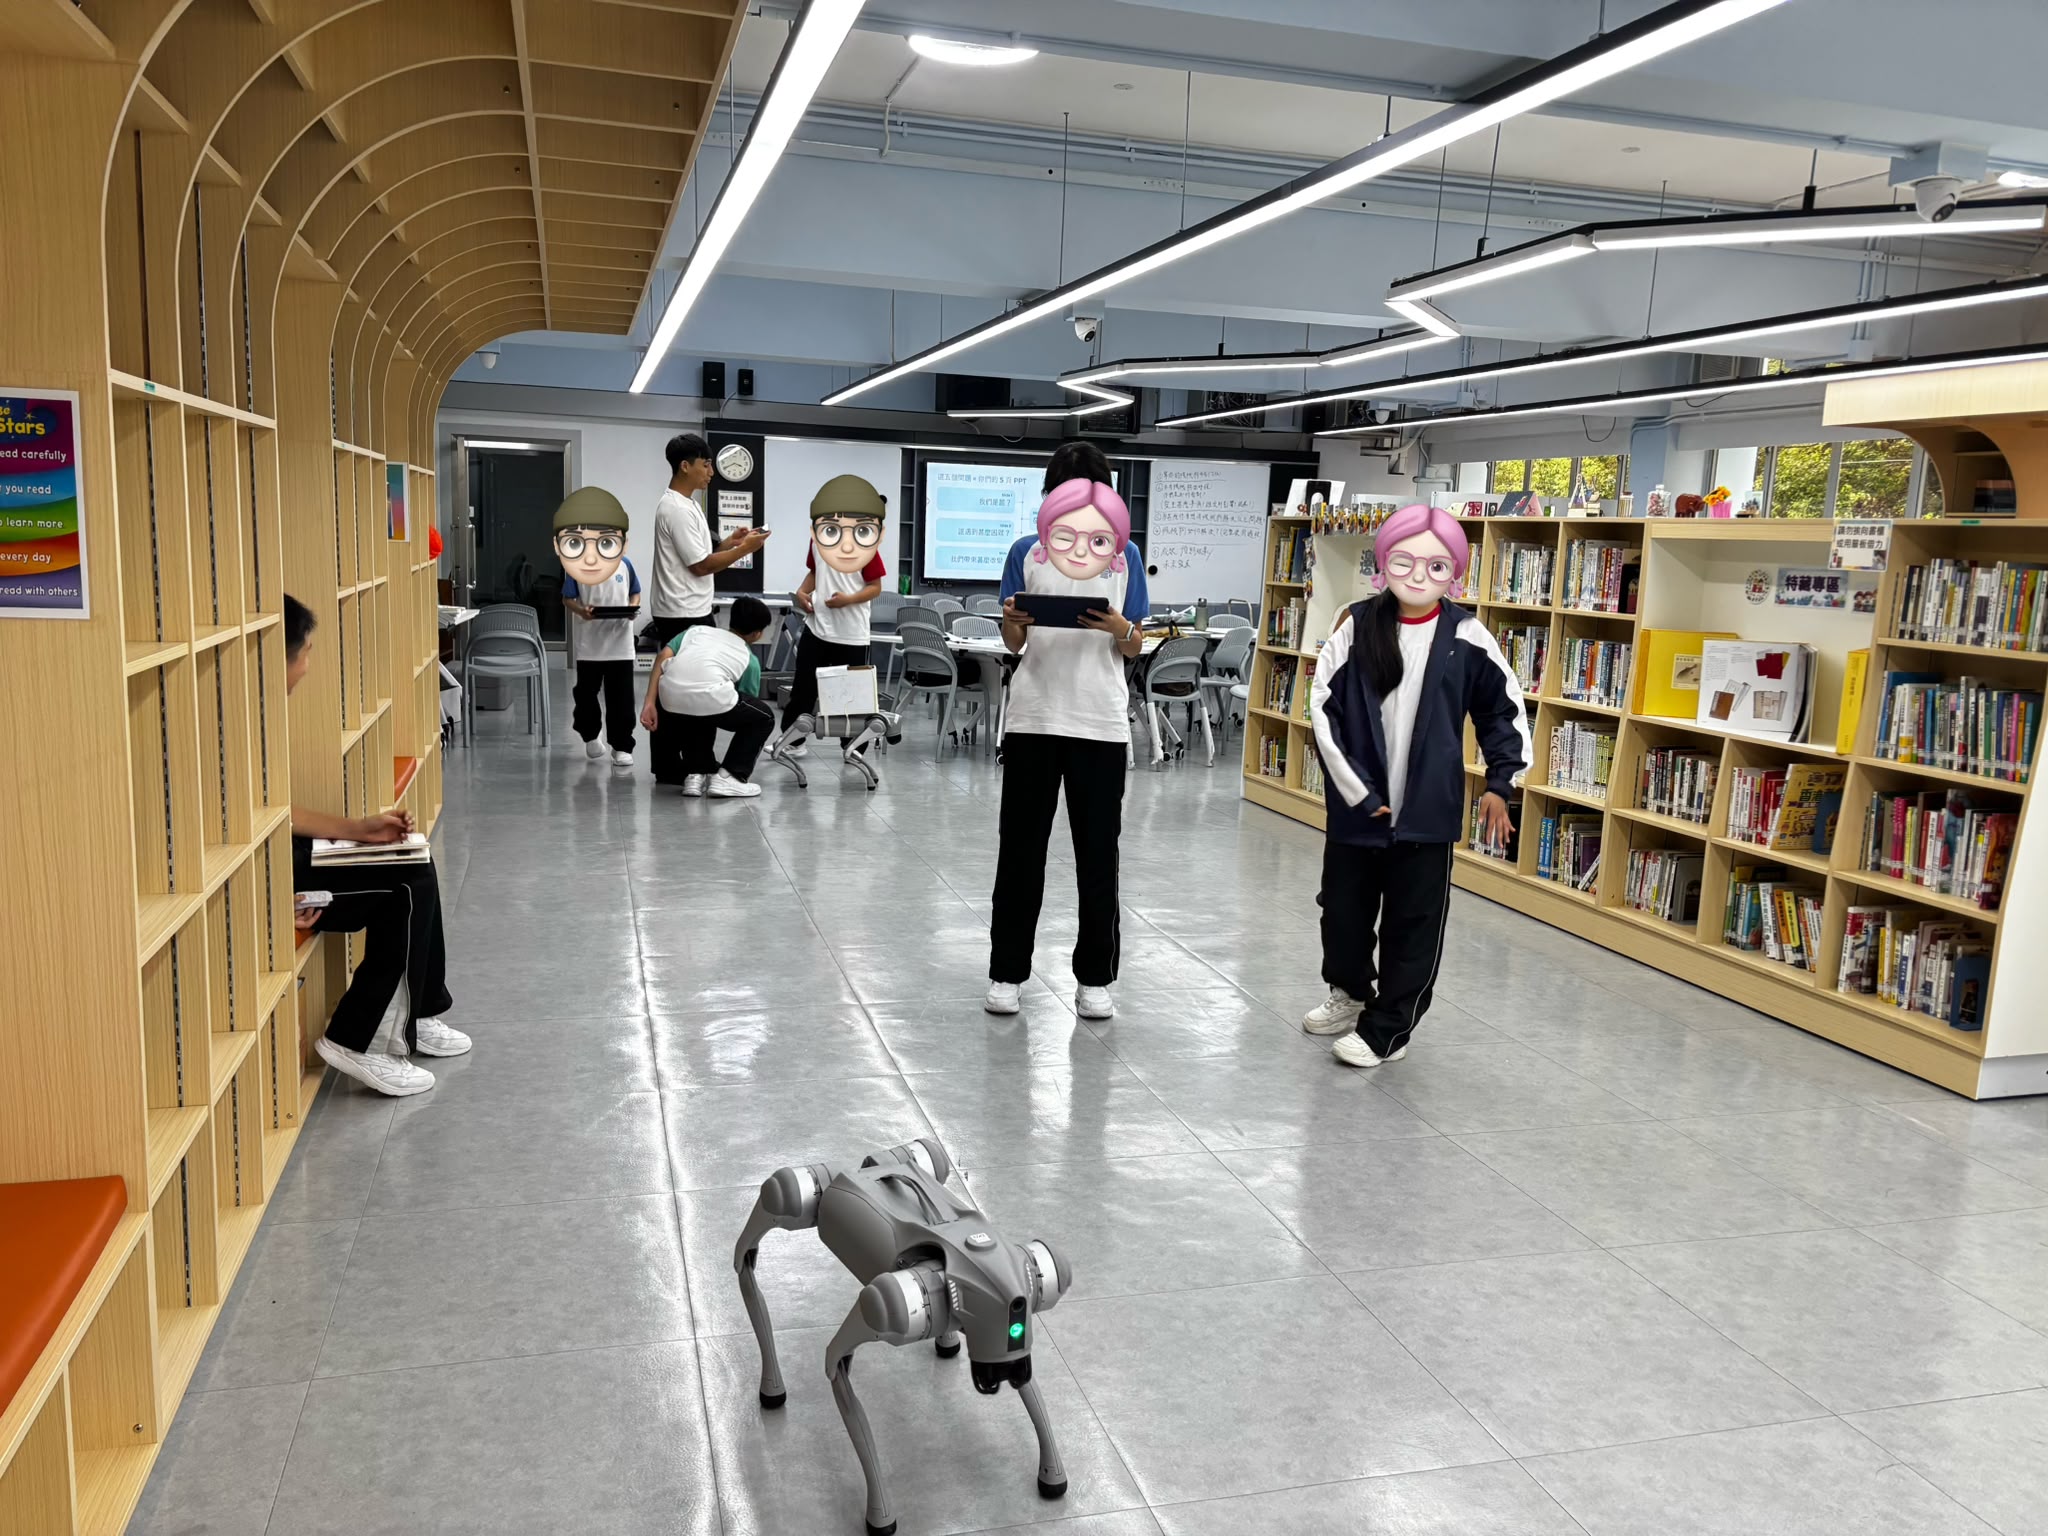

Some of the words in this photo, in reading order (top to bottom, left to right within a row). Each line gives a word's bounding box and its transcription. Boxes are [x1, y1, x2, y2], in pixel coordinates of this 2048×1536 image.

[0, 417, 46, 436] Stars
[21, 450, 67, 463] carefully
[1013, 477, 1027, 485] PPT
[5, 485, 24, 495] you
[27, 485, 52, 495] read
[6, 517, 34, 527] learn
[0, 553, 29, 563] every
[32, 552, 51, 564] day
[1785, 575, 1841, 593] 特藏專區
[25, 586, 45, 595] with
[48, 586, 78, 596] others
